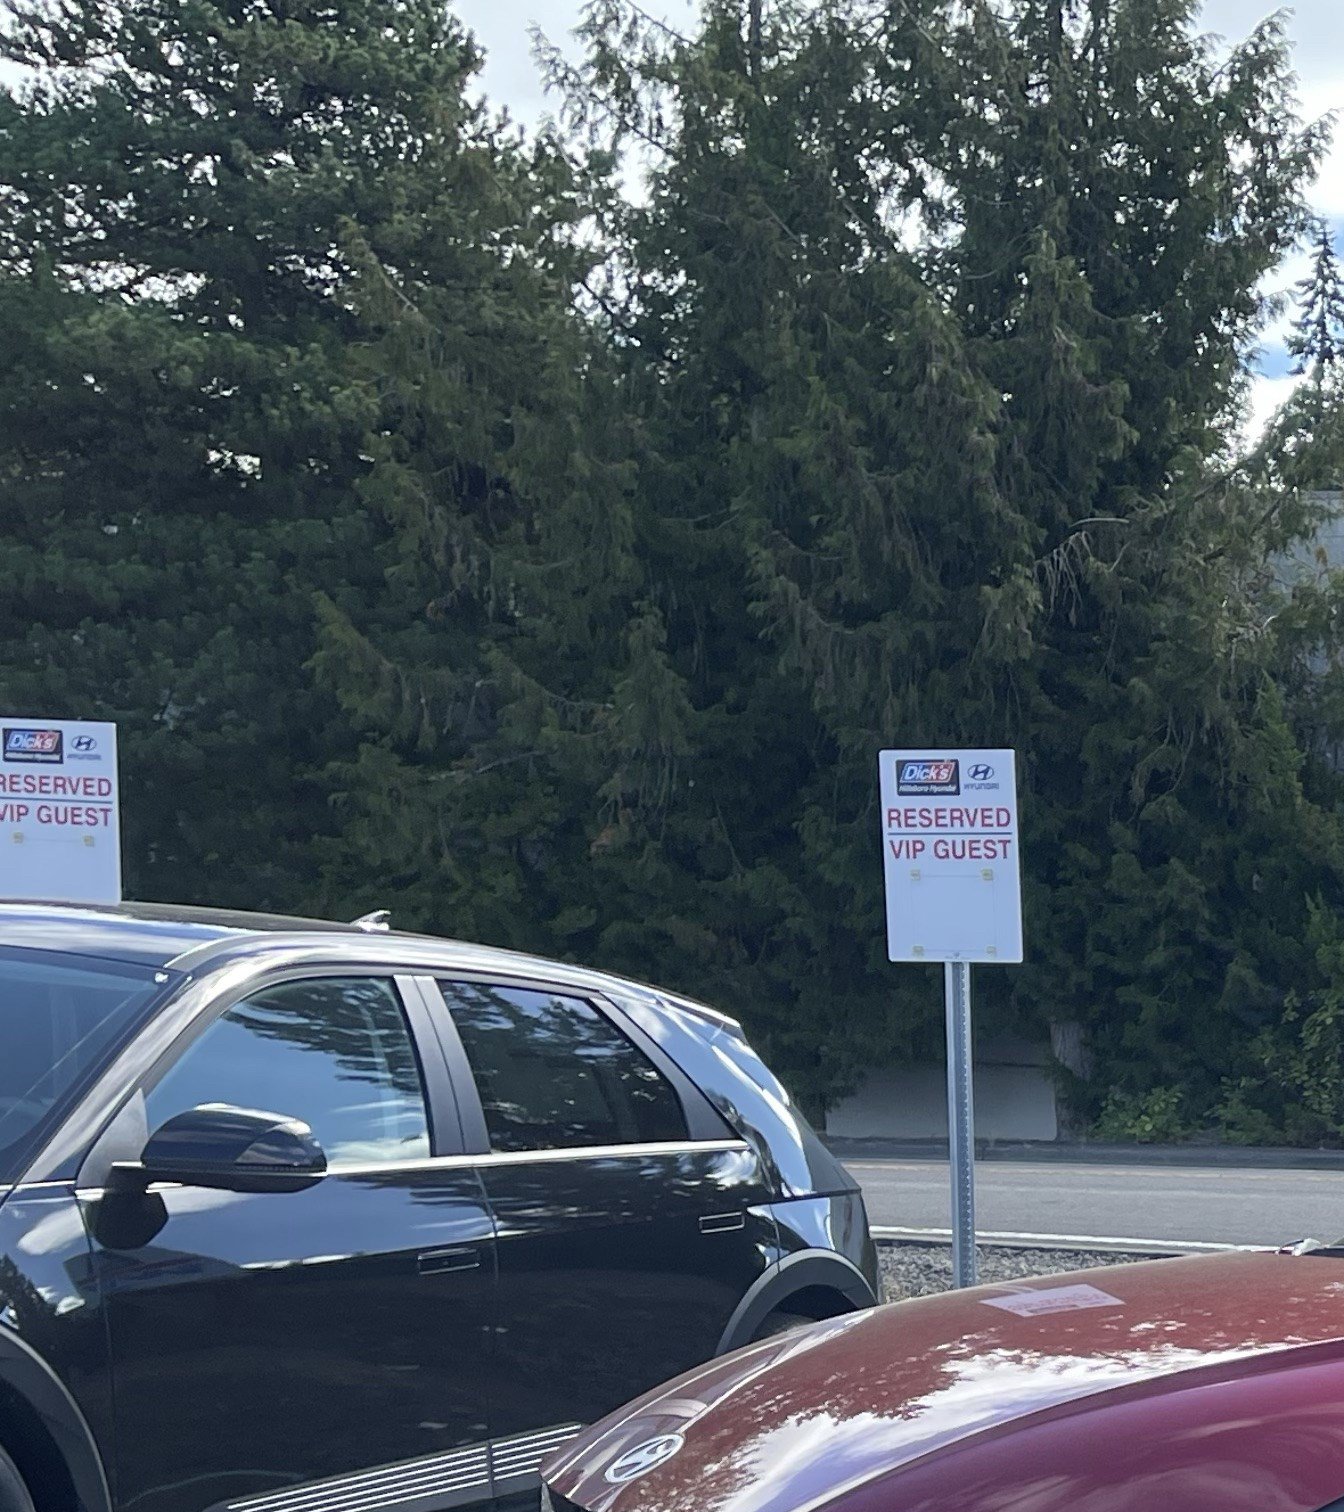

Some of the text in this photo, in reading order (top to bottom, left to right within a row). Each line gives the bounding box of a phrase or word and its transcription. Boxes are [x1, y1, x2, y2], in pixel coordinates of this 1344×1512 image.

[0, 804, 112, 826] VIP GUEST
[888, 808, 1011, 828] RESERVED
[889, 840, 1011, 860] VIP GUEST
